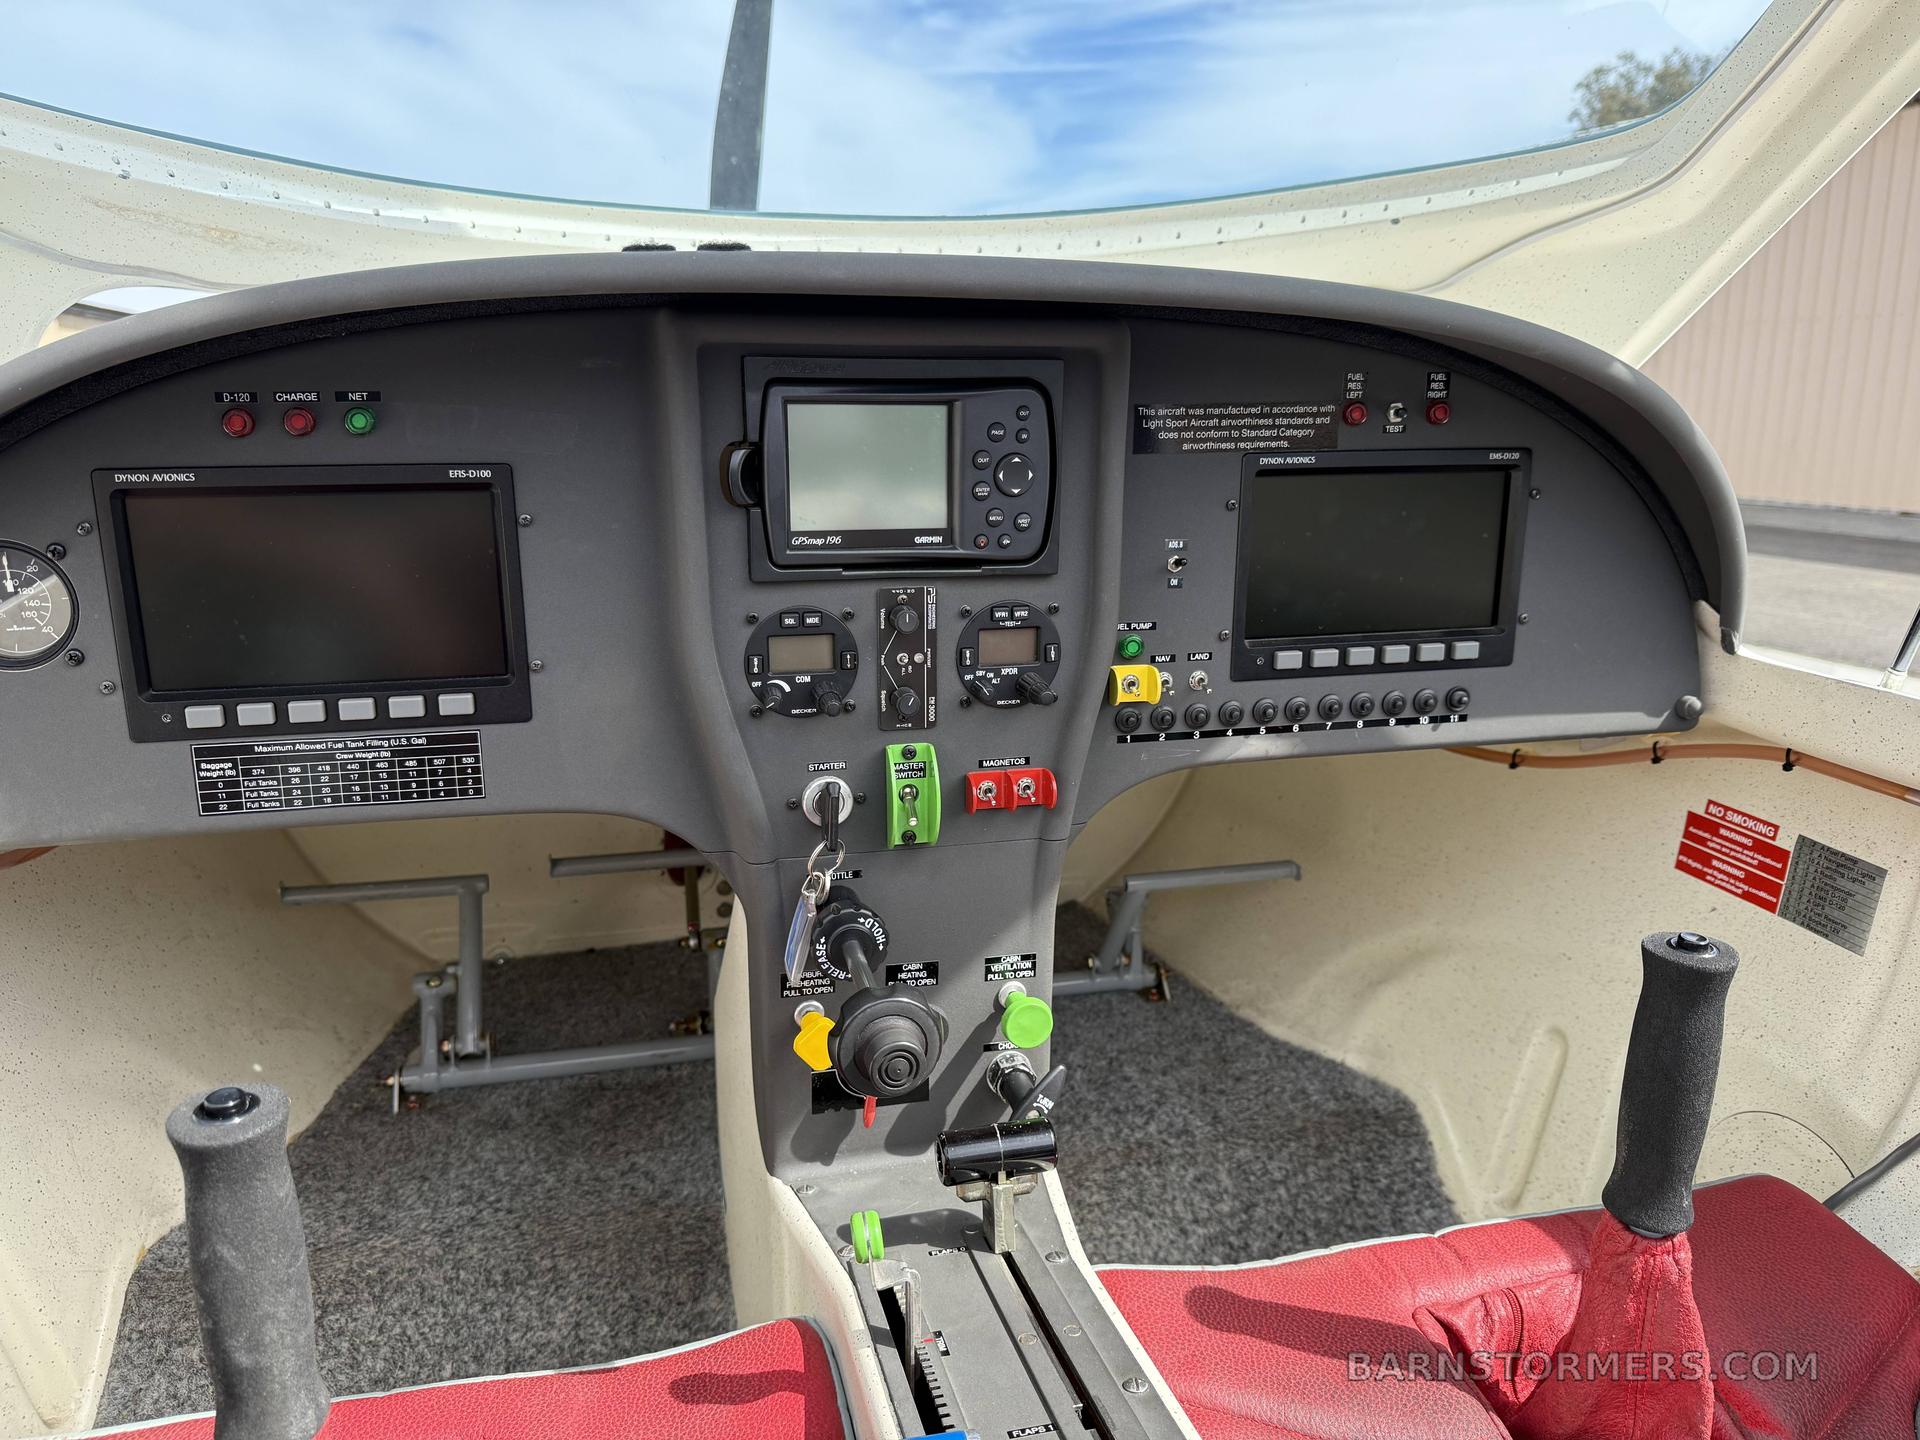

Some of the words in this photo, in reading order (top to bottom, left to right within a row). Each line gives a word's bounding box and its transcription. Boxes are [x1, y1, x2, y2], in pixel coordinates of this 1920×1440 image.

[223, 392, 250, 402] D-120
[275, 392, 318, 402] CHARGE
[348, 392, 368, 401] NET
[1138, 407, 1156, 416] This
[1158, 406, 1186, 416] aircraft
[1206, 405, 1261, 414] manufactured
[1263, 405, 1270, 414] in
[1272, 405, 1318, 414] accordance
[1320, 404, 1336, 412] with
[1142, 419, 1163, 429] Light
[1166, 418, 1188, 428] Sport
[1190, 417, 1219, 426] Aircraft
[1220, 417, 1273, 426] airworthiness
[1274, 416, 1314, 425] standards
[1315, 416, 1330, 424] and
[1158, 431, 1178, 439] does
[1196, 430, 1230, 438] conform
[1241, 428, 1278, 438] Standard
[1279, 428, 1315, 438] Category
[1182, 441, 1236, 450] airworthiness
[1237, 440, 1290, 450] requirements.
[1260, 457, 1284, 465] DYNON
[1285, 456, 1316, 464] AVIONICS
[114, 474, 150, 482] DYNON
[152, 472, 196, 482] AVIONICS
[448, 470, 492, 478] EFIS-D100
[791, 536, 826, 547] GPSmap
[826, 535, 842, 545] 196
[914, 535, 943, 544] GARMIN
[26, 564, 38, 572] 20
[796, 676, 811, 684] COM
[1126, 736, 1131, 744] 1
[1159, 733, 1166, 741] 2
[1194, 731, 1200, 740] 3
[1226, 729, 1233, 737] 4
[1260, 726, 1266, 735] 5
[1292, 724, 1300, 732] 6
[1326, 722, 1332, 730] 7
[1356, 720, 1364, 728] 8
[1389, 718, 1396, 726] 9
[1419, 716, 1430, 724] 10
[1450, 714, 1459, 722] 11
[254, 744, 294, 753] Maximum
[294, 742, 326, 752] Allowed
[328, 741, 345, 750] Fuel
[347, 740, 365, 748] Tank
[366, 739, 389, 748] Filling
[390, 738, 410, 747] (U.S.
[411, 737, 428, 746] Gal)
[355, 751, 380, 760] Weight
[380, 750, 392, 758] (lb)
[200, 762, 233, 770] Baggage
[808, 762, 846, 771] STARTER
[982, 758, 1026, 767] MAGNETOS
[199, 770, 224, 778] Weight
[225, 768, 237, 778] (lb)
[895, 771, 924, 779] SWITCH
[1708, 804, 1724, 817] NO
[1725, 811, 1776, 837] SMOKING
[1718, 828, 1753, 846] WARNING
[1712, 858, 1745, 878] WARNING
[1846, 872, 1866, 886] Lights
[1856, 868, 1876, 882] Lights
[865, 918, 886, 944] HOLD
[816, 942, 847, 980] RELEASE
[1001, 955, 1021, 963] CABIN
[902, 963, 923, 971] CABIN
[991, 961, 1032, 972] VENTILATION
[898, 970, 928, 979] HEATING
[988, 972, 1004, 980] PULL
[1016, 970, 1034, 978] OPEN
[917, 978, 936, 986] OPEN
[784, 989, 801, 997] PULL
[814, 986, 834, 994] OPEN
[1037, 1094, 1055, 1110] TURN
[1012, 1426, 1046, 1438] FLAPS
